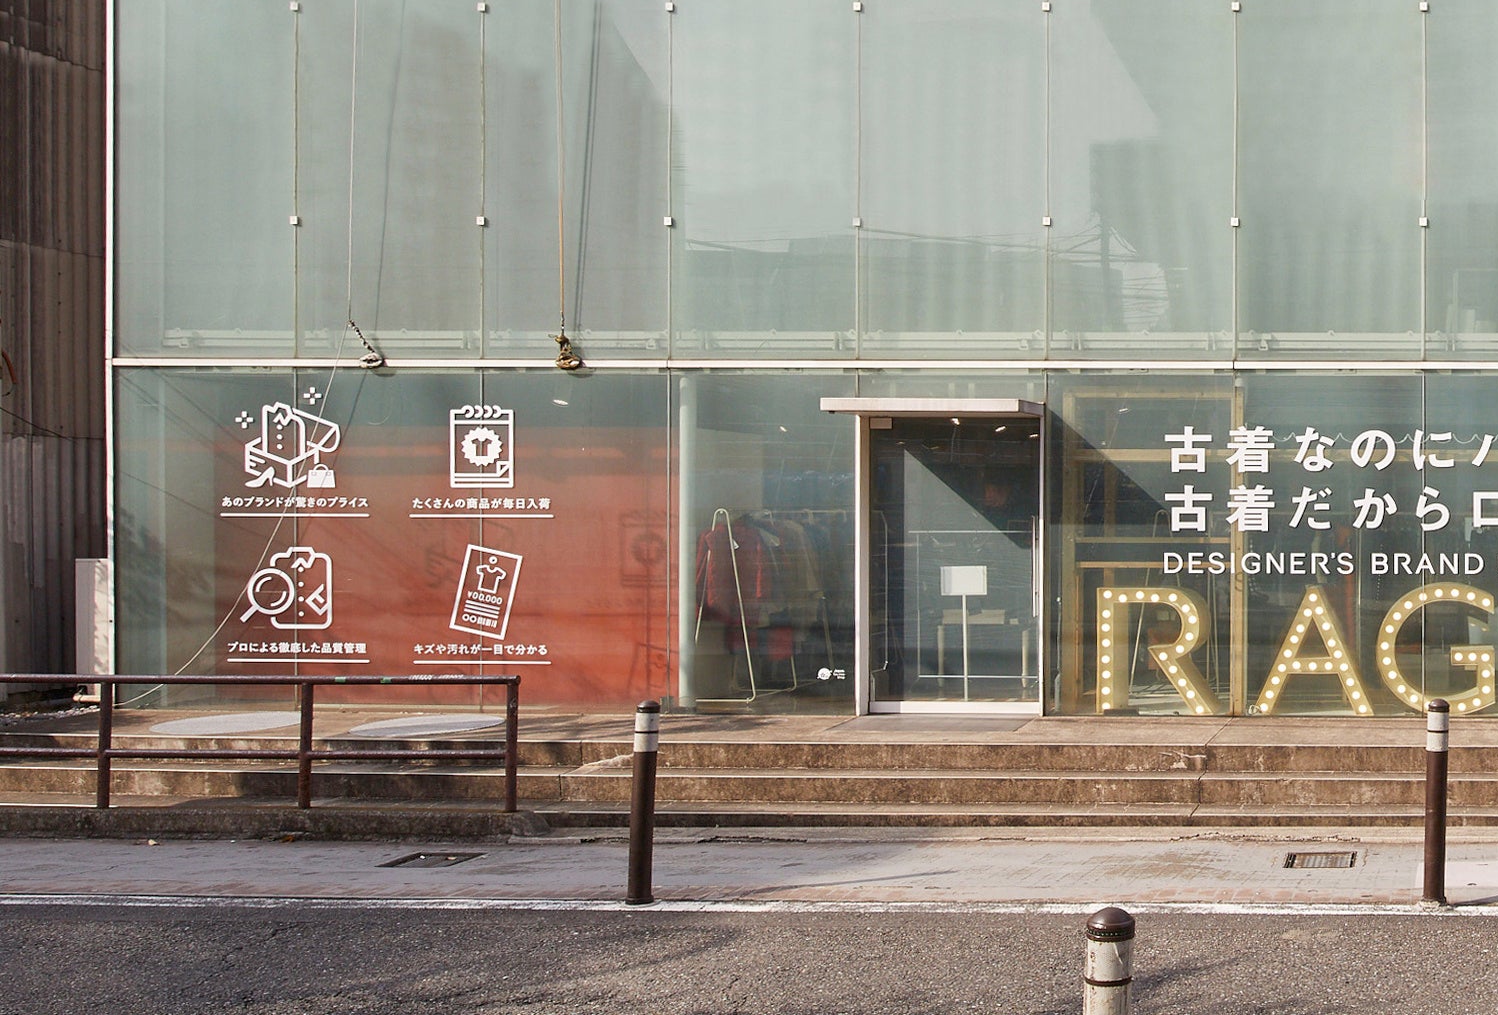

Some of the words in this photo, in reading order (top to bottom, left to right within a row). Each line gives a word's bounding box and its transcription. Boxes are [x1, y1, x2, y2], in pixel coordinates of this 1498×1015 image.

[412, 497, 551, 510] たくさんの商品が毎日入荷
[1162, 551, 1354, 576] DESIGNER'S
[1371, 551, 1486, 576] BRAND
[227, 641, 367, 654] プロによる徹底した品質管理
[413, 643, 548, 655] キズや汚れが一目で分かる
